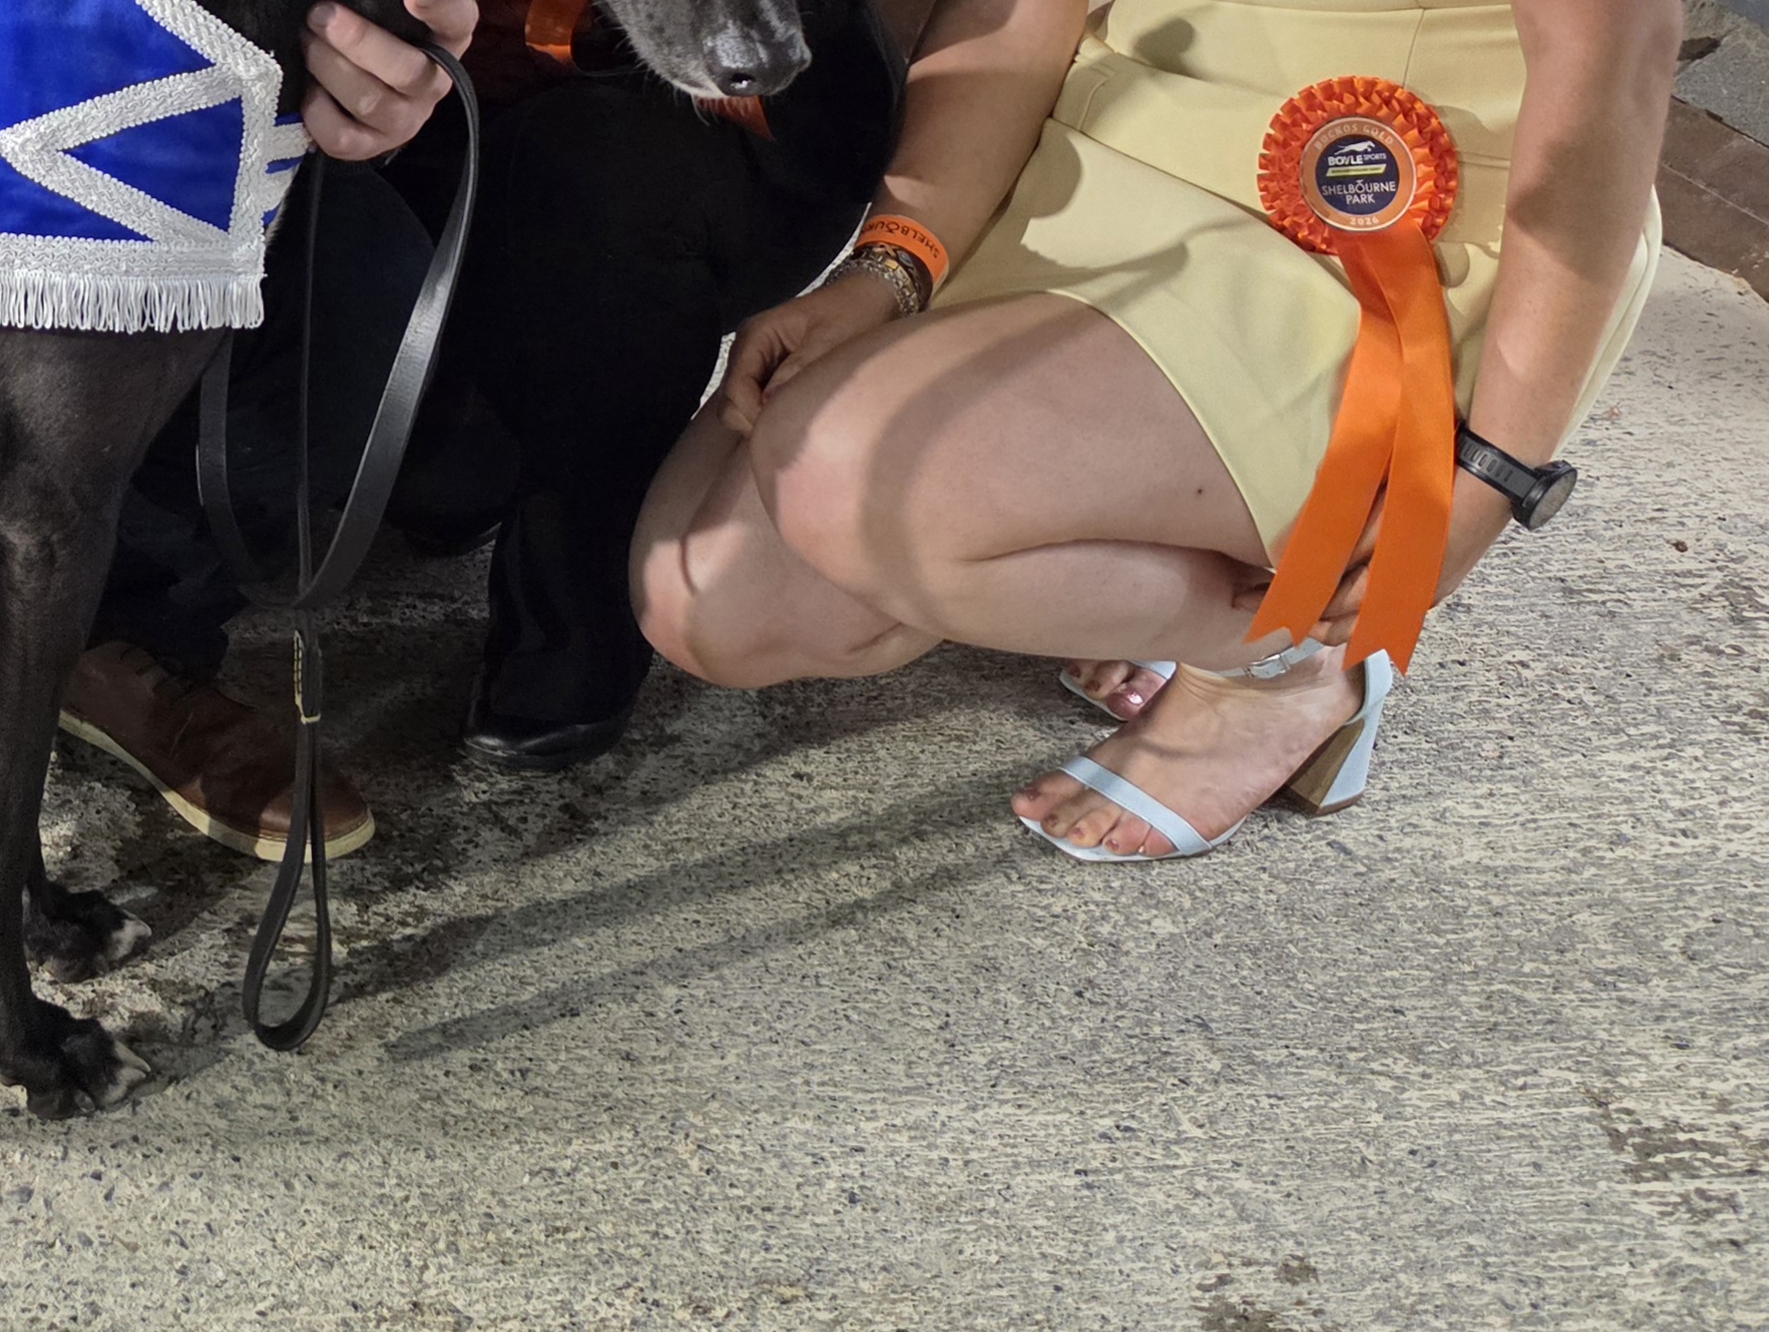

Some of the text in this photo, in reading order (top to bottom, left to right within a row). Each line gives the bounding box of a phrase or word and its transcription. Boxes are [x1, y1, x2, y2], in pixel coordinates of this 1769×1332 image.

[1327, 154, 1364, 166] BOYLE
[1345, 193, 1376, 205] PARK
[1349, 216, 1380, 226] 2026
